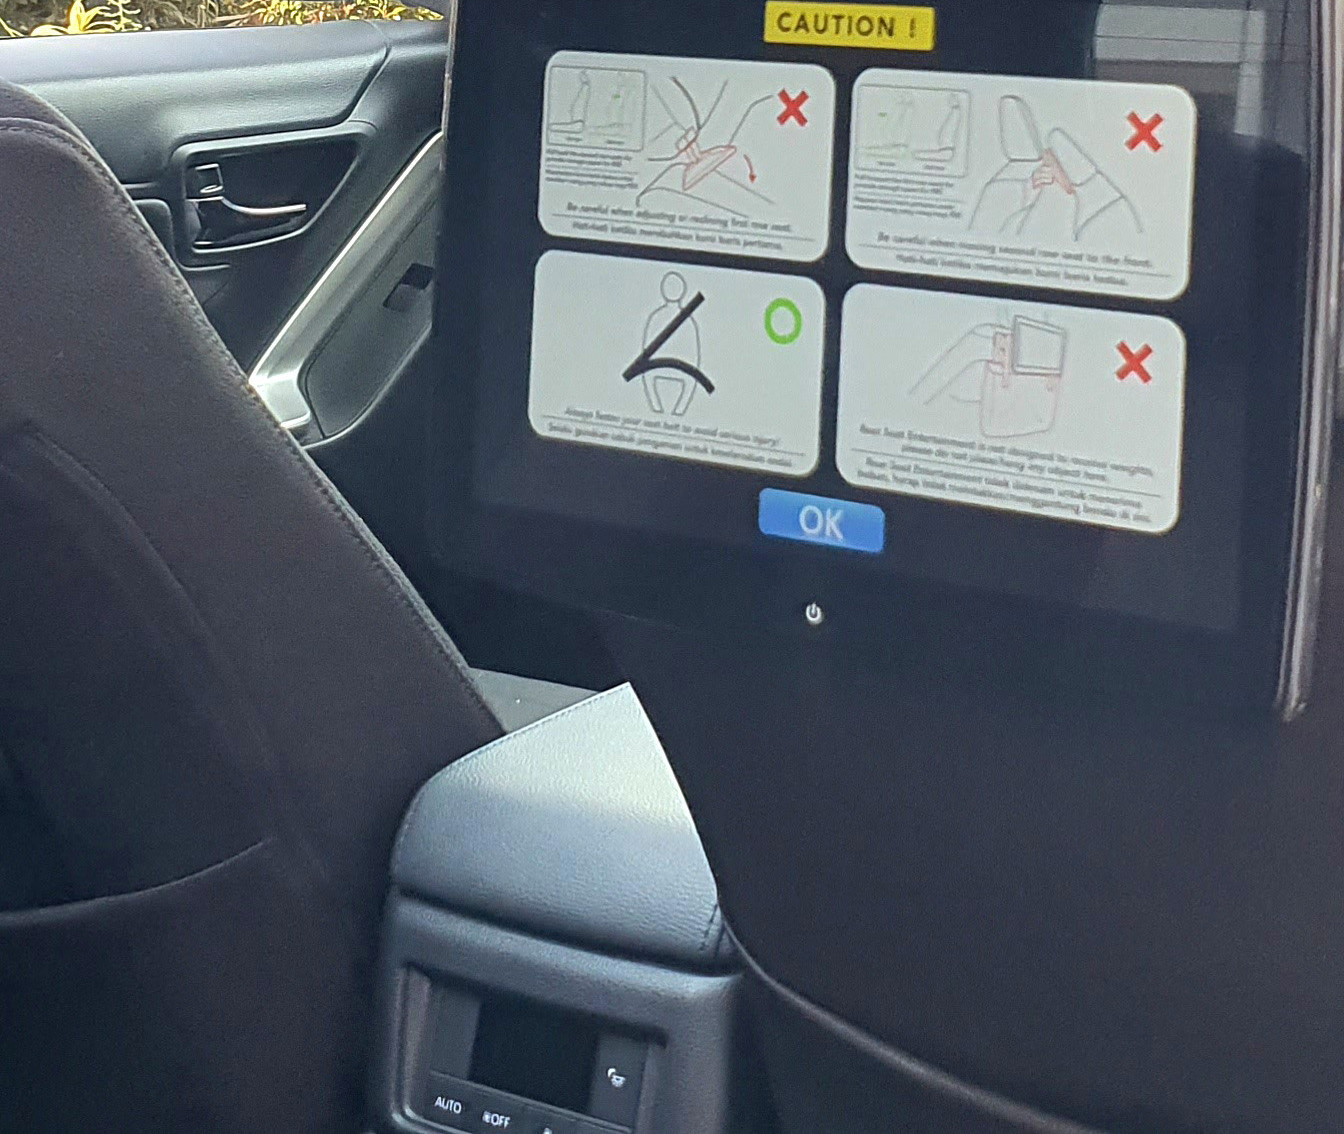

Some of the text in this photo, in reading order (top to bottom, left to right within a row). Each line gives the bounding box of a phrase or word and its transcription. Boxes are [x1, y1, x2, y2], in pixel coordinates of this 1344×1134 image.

[777, 12, 895, 37] CAUTION
[799, 505, 844, 542] OK
[434, 1096, 461, 1114] AUTO
[491, 1113, 510, 1129] OFF
